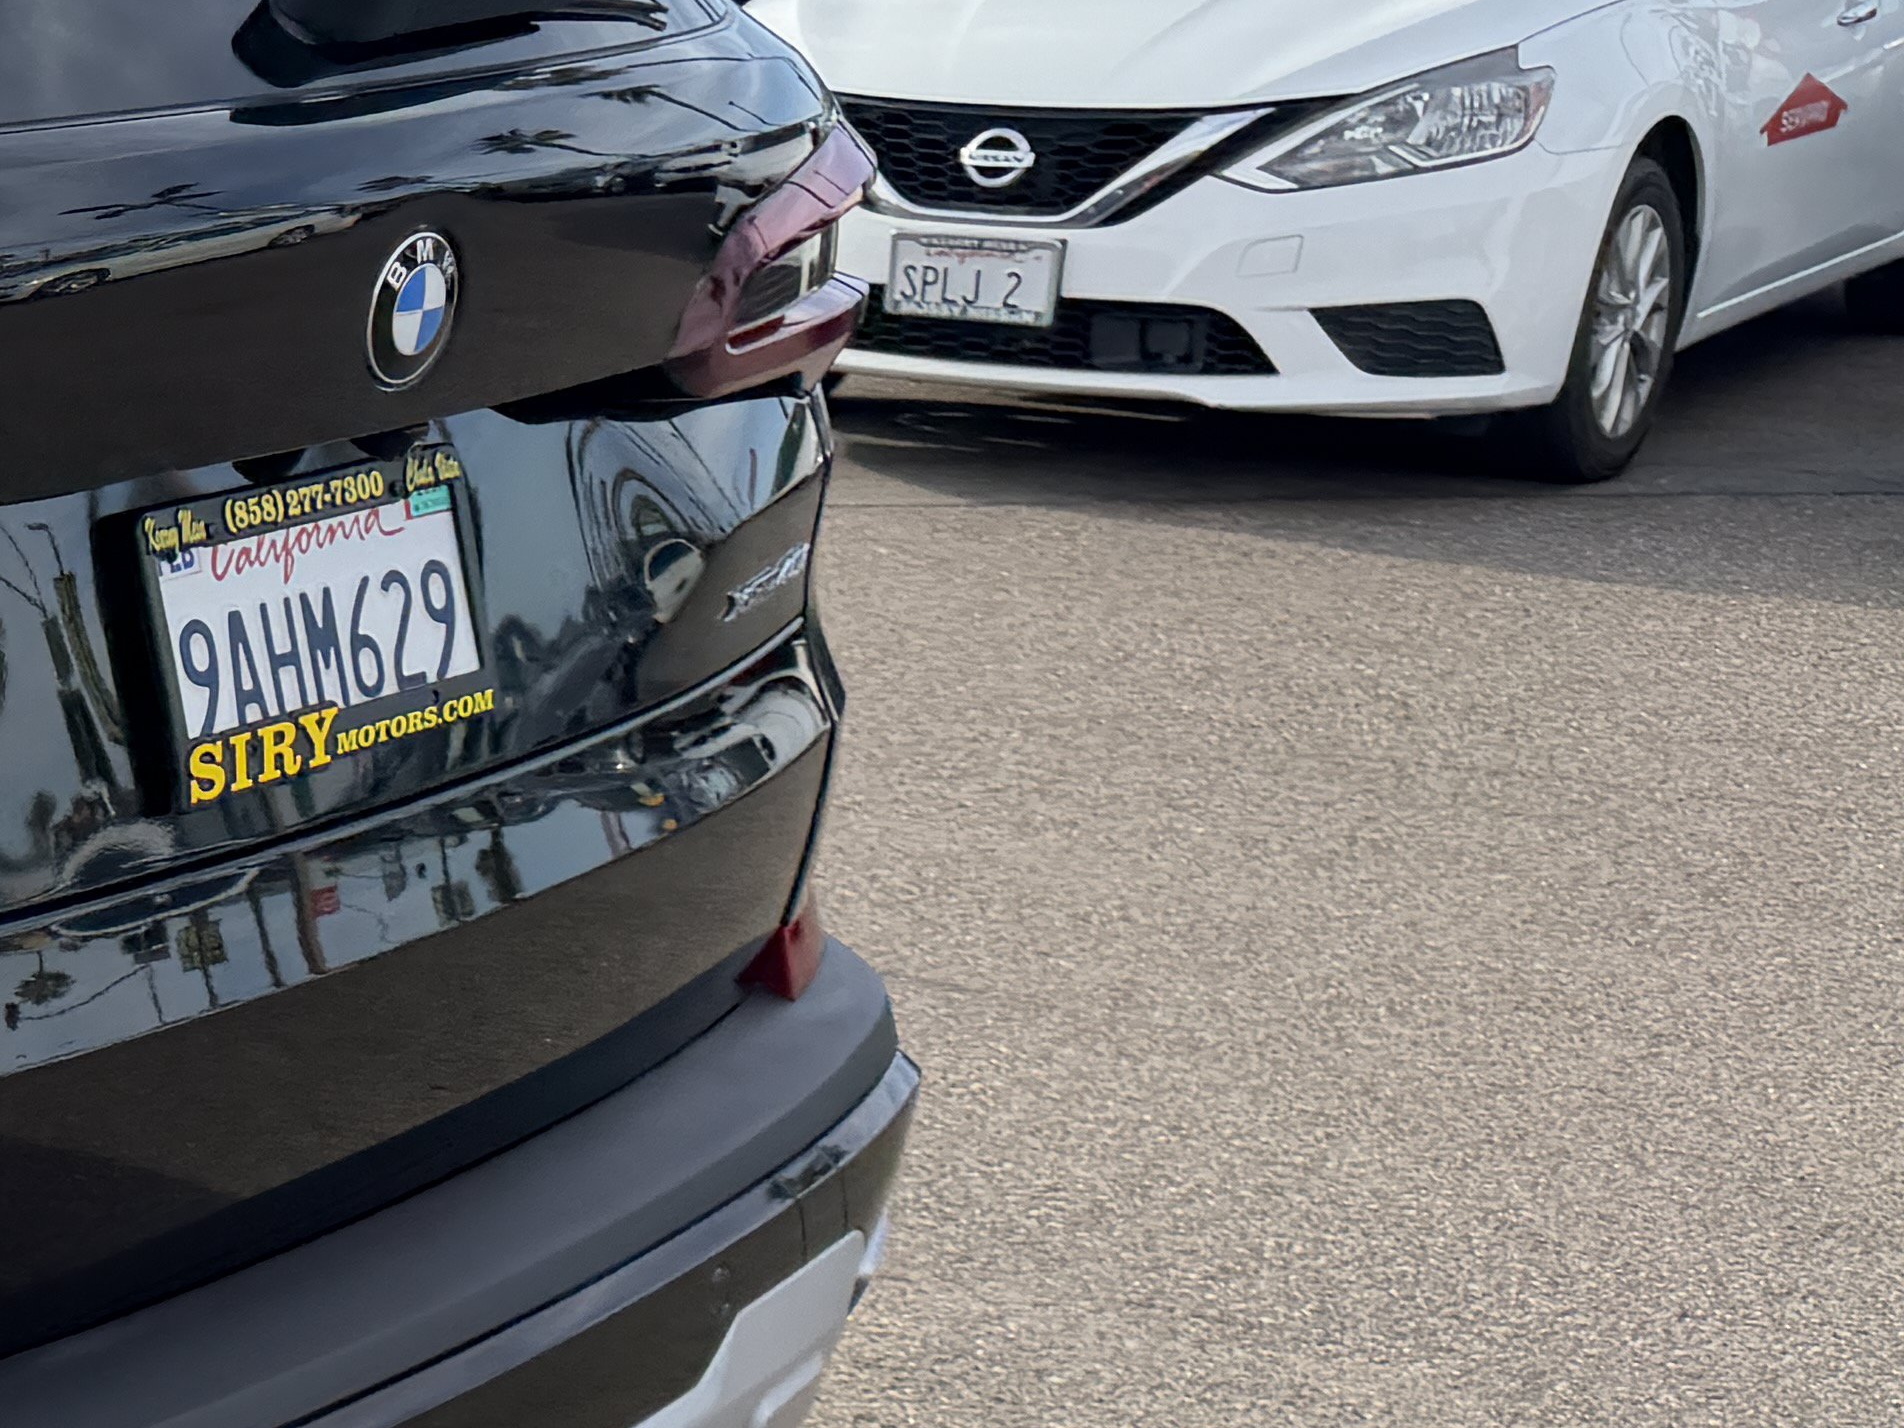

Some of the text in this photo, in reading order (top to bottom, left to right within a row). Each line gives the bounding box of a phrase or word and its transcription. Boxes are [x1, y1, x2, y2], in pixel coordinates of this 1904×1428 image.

[1002, 271, 1023, 309] 2
[224, 489, 285, 533] (858)
[286, 470, 384, 514] 277-7300
[210, 508, 406, 584] California
[179, 559, 456, 738] 9AHM629
[190, 689, 494, 805] SIRY MOTORS.COM
